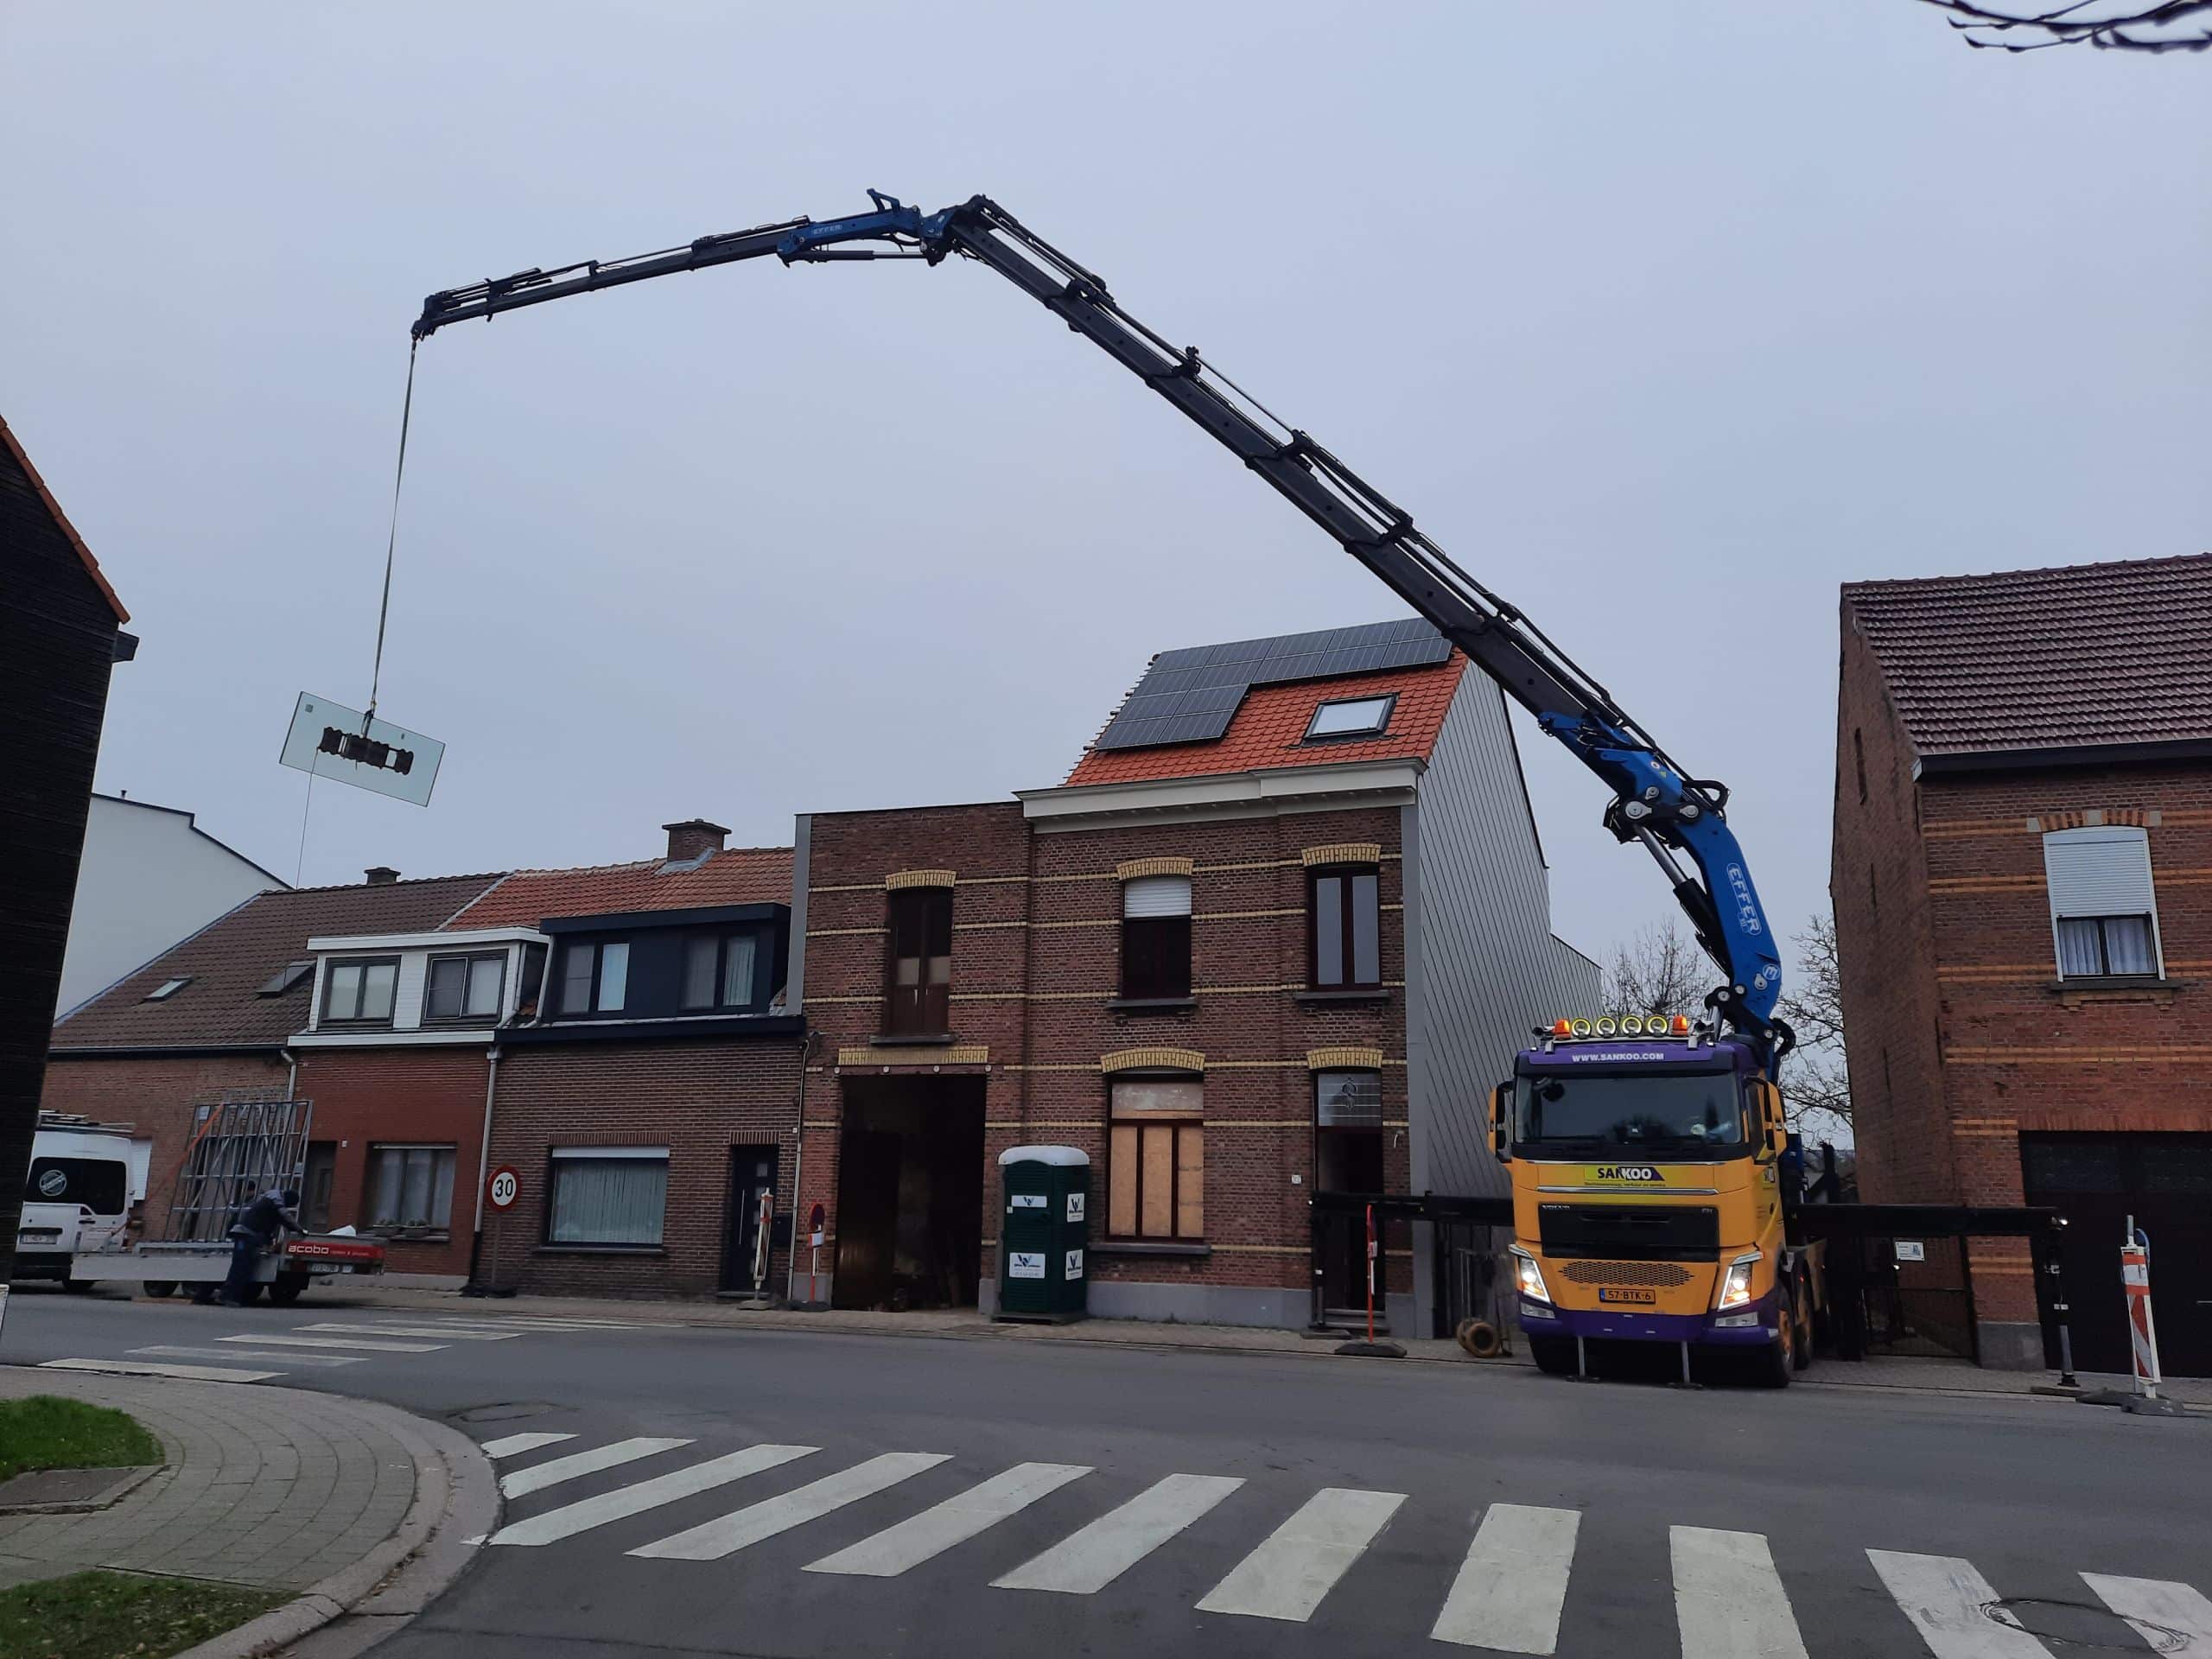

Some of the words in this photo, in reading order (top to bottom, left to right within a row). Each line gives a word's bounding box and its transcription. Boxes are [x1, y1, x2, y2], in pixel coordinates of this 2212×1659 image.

[1729, 867, 1760, 932] EFFER
[1572, 1052, 1664, 1063] WWW.SANKOO.COM
[1598, 1167, 1652, 1180] SANKOO
[495, 1179, 513, 1198] 30
[288, 1244, 329, 1255] acobo
[1609, 1290, 1651, 1300] 57-BTK-6
